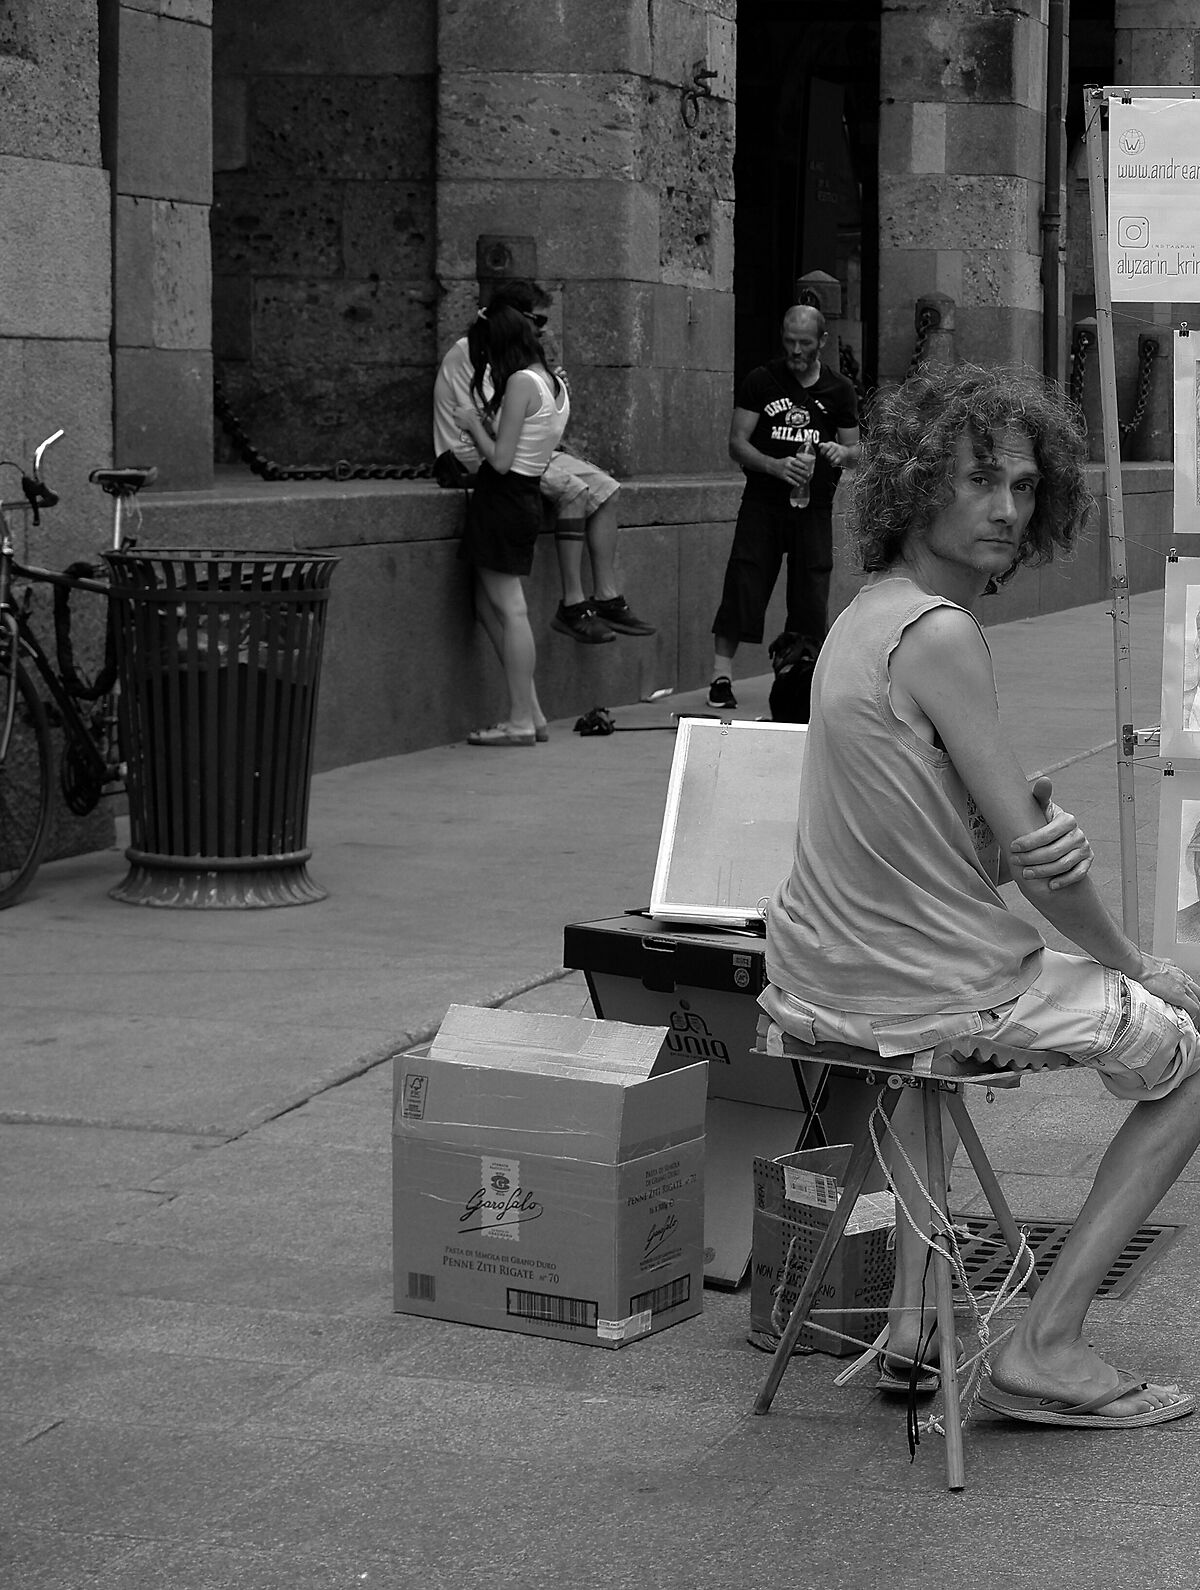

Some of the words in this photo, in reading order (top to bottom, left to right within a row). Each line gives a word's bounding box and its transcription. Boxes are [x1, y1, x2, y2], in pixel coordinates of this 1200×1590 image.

[771, 426, 820, 444] MILANO
[459, 1187, 544, 1226] Garofalo
[477, 1261, 497, 1274] ZITI
[500, 1265, 535, 1280] RIGATE
